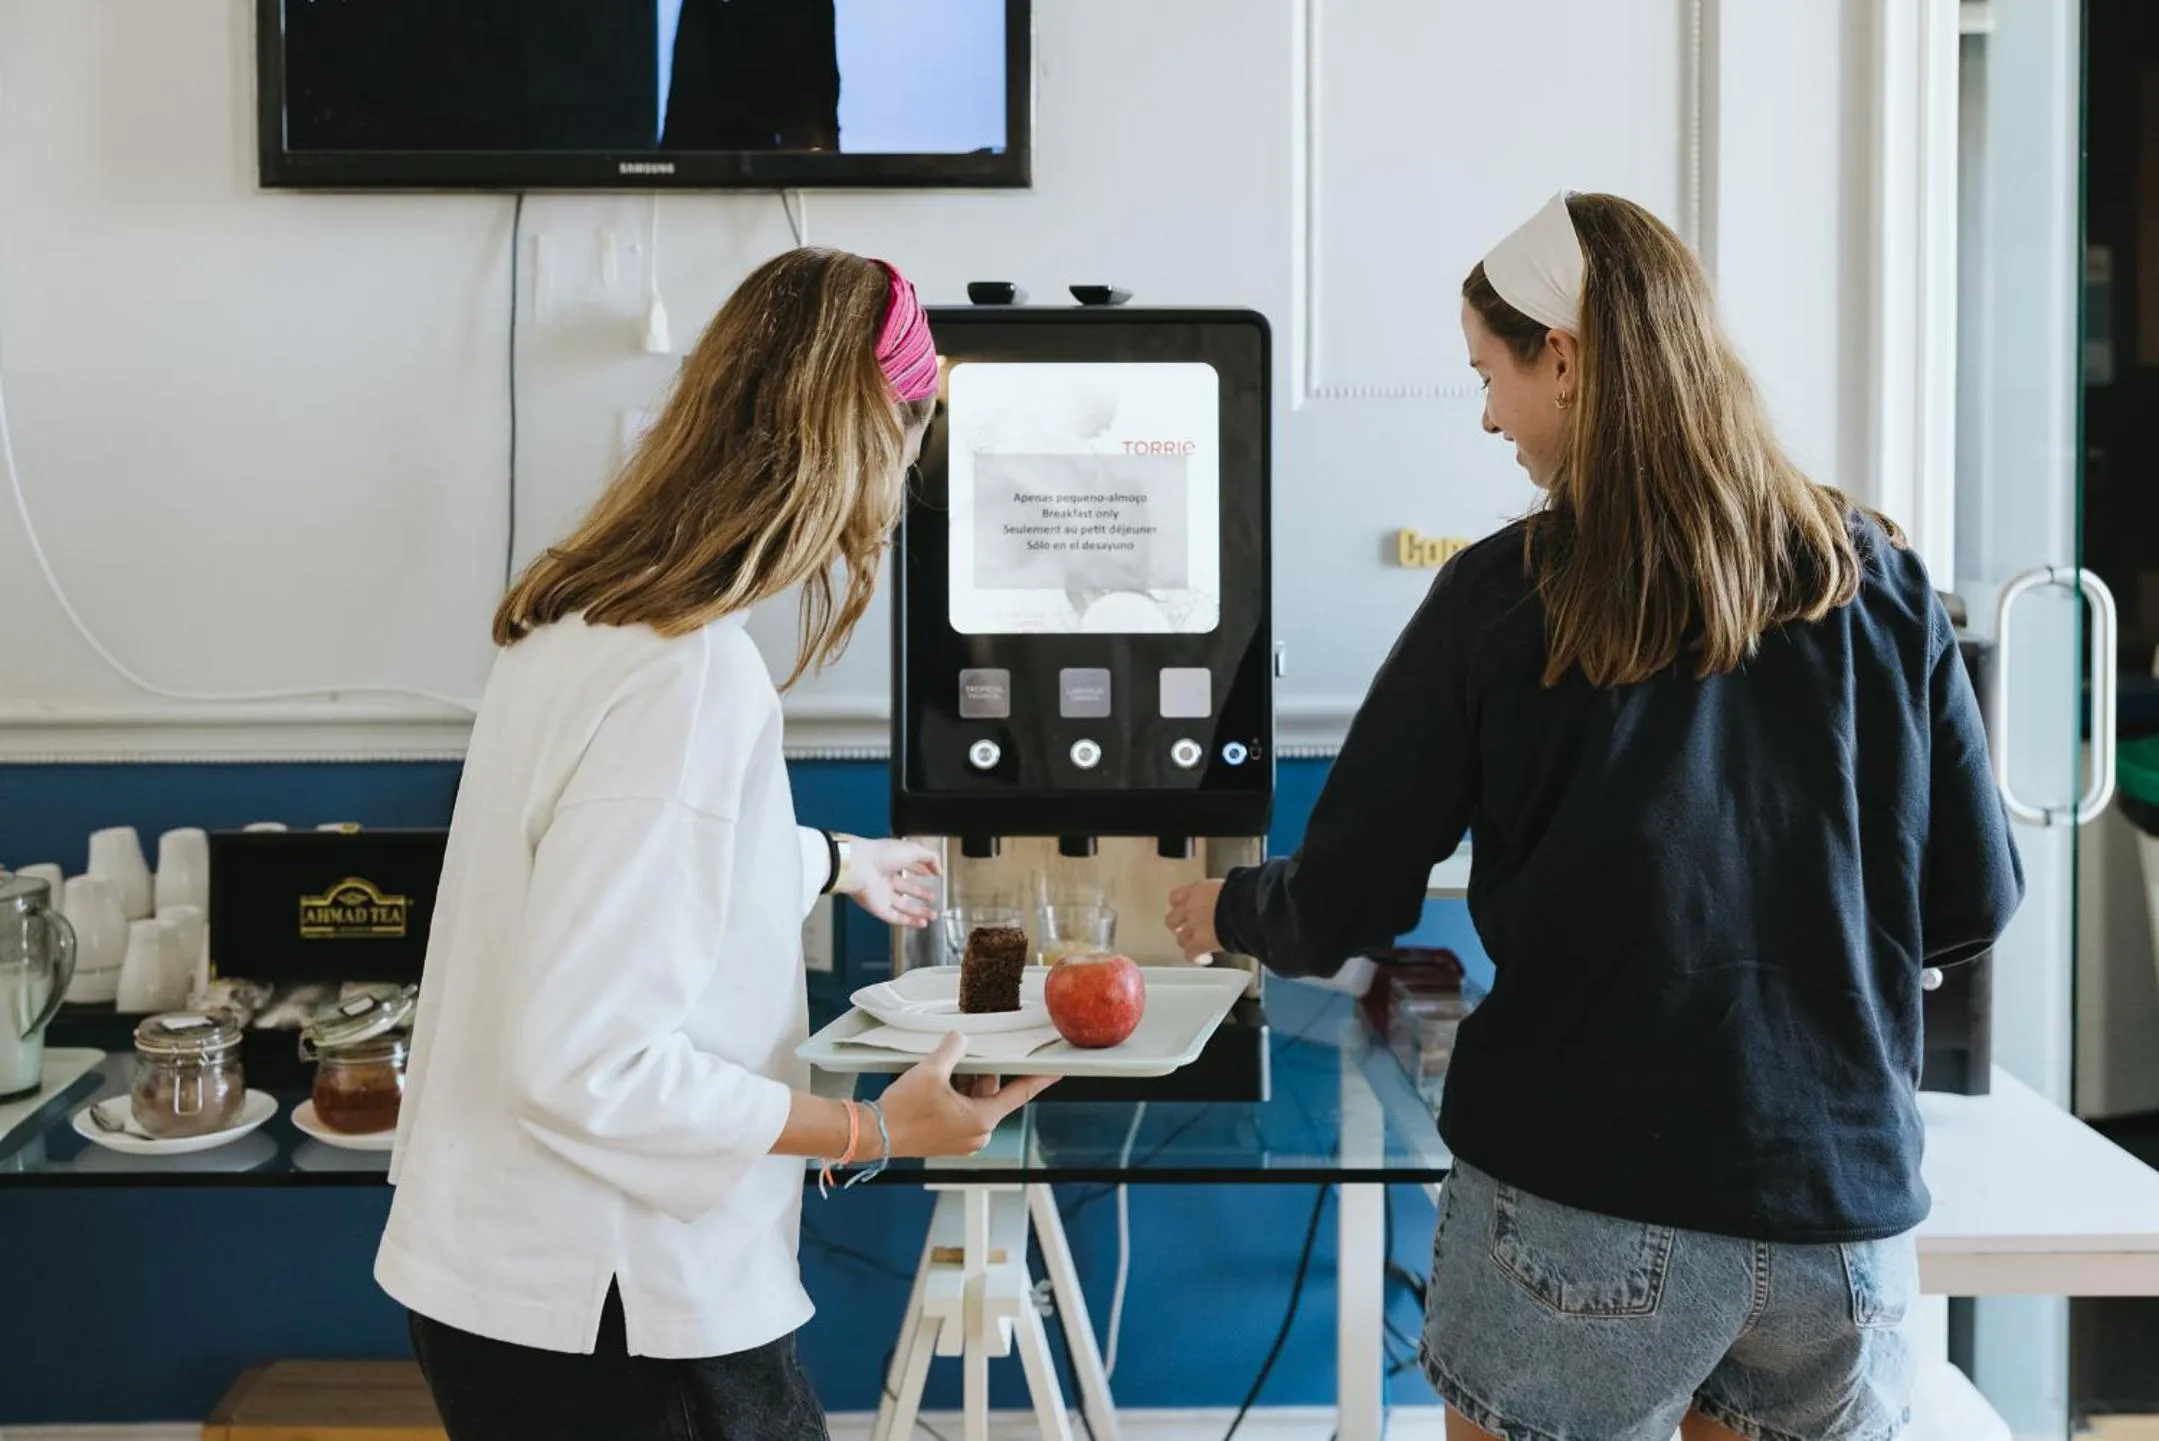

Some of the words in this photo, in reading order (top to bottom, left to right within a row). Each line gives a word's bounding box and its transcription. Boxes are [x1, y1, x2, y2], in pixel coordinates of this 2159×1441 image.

[1013, 493, 1052, 504] Apenas
[1042, 509, 1092, 518] Breakfast
[1096, 509, 1119, 520] only
[1003, 525, 1060, 534] Seulement
[1081, 525, 1106, 535] petit
[1109, 525, 1157, 536] déjeuner
[1027, 540, 1050, 550] Sólo
[1070, 540, 1079, 550] el
[1082, 540, 1134, 552] desayuno
[306, 906, 367, 925] AHMAD
[369, 906, 401, 925] TEA
